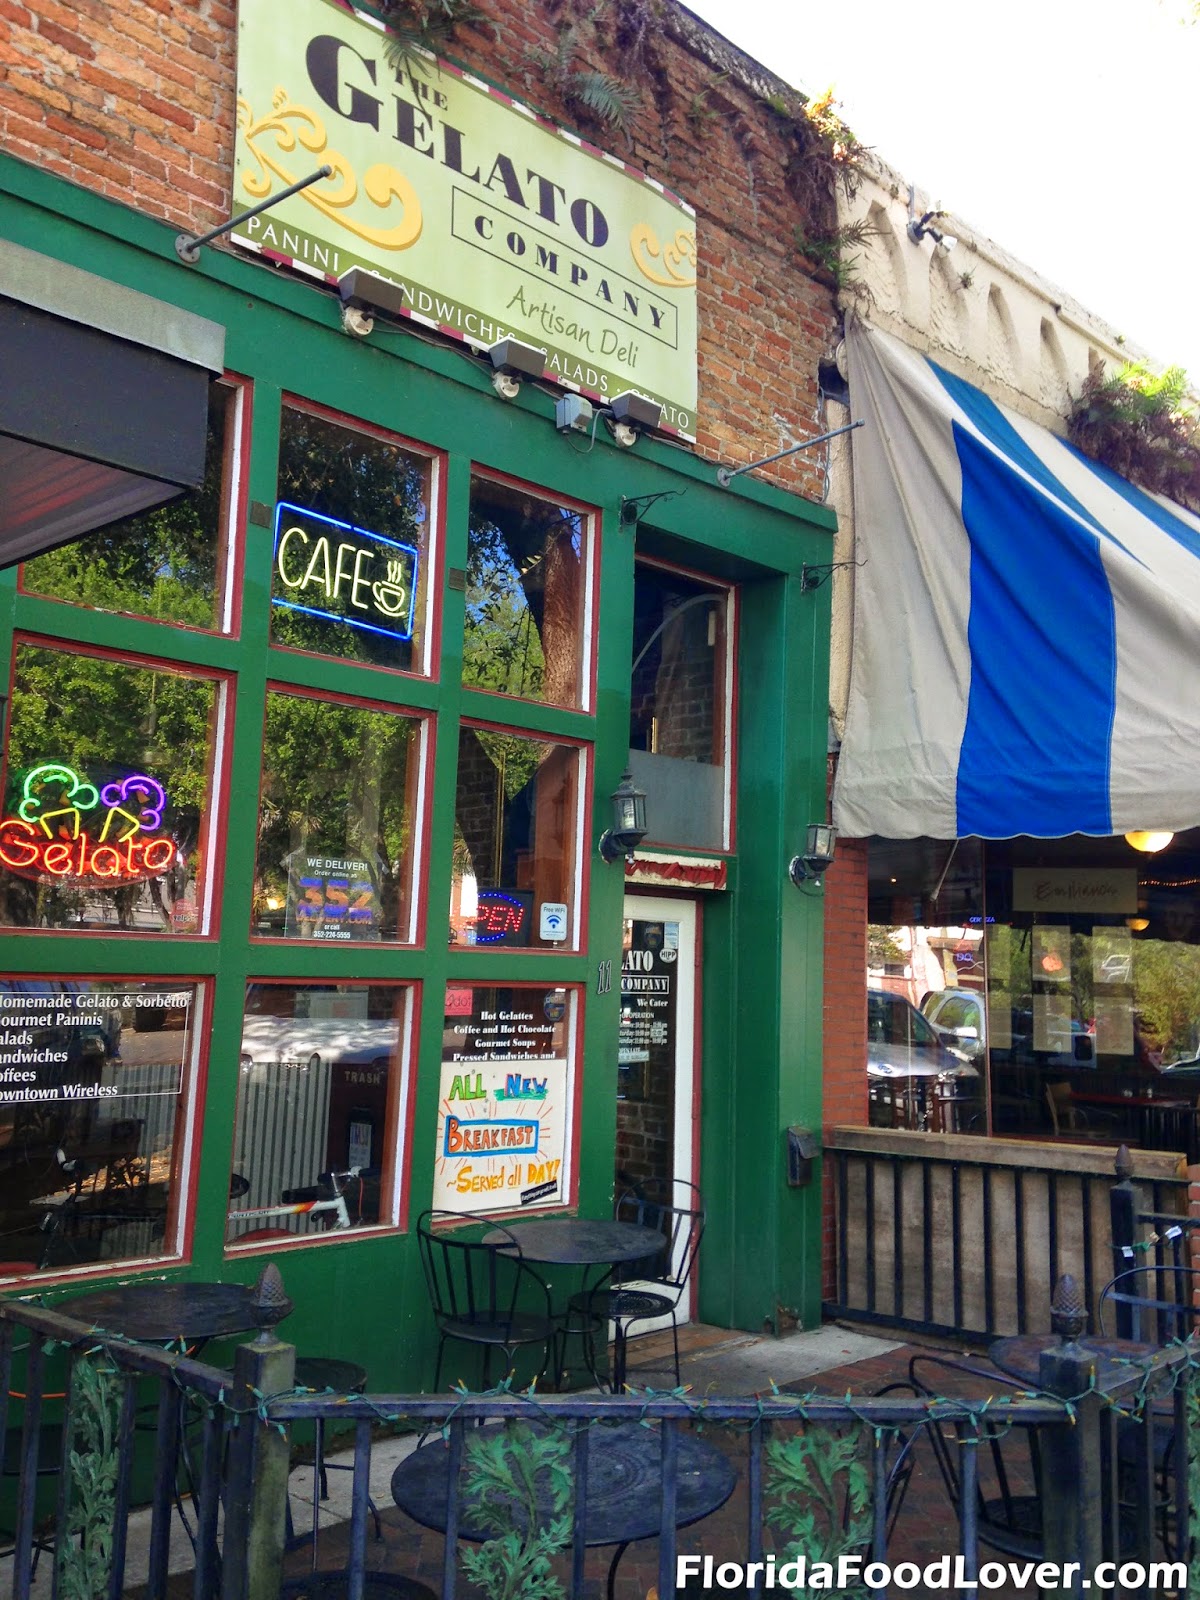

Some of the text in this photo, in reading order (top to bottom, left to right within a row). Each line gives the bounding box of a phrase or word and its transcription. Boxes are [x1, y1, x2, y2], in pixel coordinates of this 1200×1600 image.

[391, 64, 449, 112] THE
[305, 34, 610, 249] GELATO
[247, 216, 339, 272] PANINI
[370, 269, 516, 344] NDWICHE
[474, 214, 666, 331] COMPANY
[506, 284, 639, 369] Artisan Deli
[278, 527, 375, 610] CAFE
[0, 819, 174, 877] Gelato
[306, 857, 322, 868] WE
[621, 950, 654, 972] ATO
[661, 950, 676, 959] HIPP
[597, 960, 612, 994] 11
[621, 977, 667, 991] COMPANY
[75, 995, 119, 1009] Gelato
[122, 995, 132, 1008] &
[135, 995, 189, 1009] Sorbetto
[636, 998, 669, 1007] We Cater
[0, 1012, 103, 1027] ourmet Paninis
[480, 1010, 534, 1021] Hot Gelattes
[453, 1024, 557, 1035] Coffee and Hot Chocolate
[474, 1038, 536, 1049] Gourmet Soups
[452, 1050, 556, 1062] Pressed Sandwiches and
[345, 1070, 381, 1085] TRASH
[449, 1073, 487, 1100] ALL
[62, 1083, 119, 1098] Wireless
[447, 1117, 534, 1154] BREAKFAST
[527, 1158, 561, 1185] DAY!
